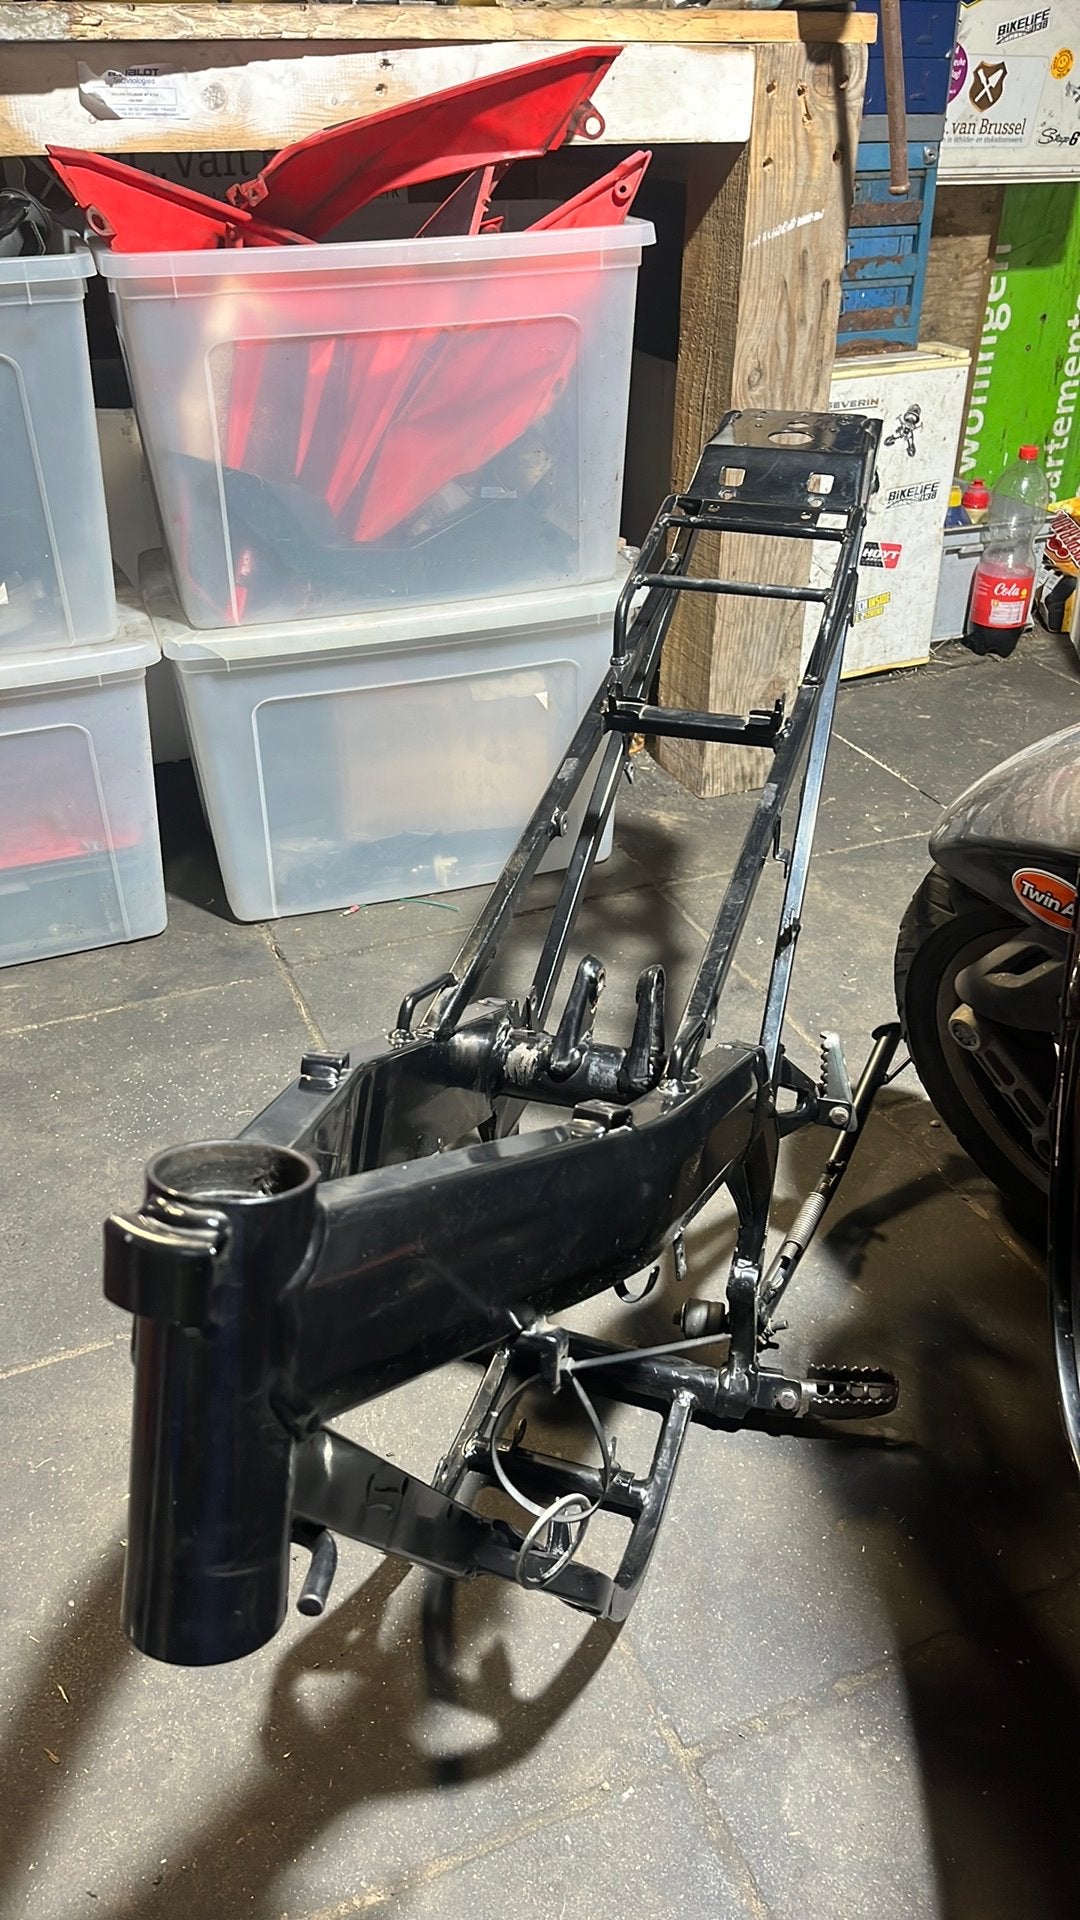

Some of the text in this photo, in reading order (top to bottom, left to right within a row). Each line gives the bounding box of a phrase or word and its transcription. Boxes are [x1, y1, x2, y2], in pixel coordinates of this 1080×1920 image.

[952, 118, 1026, 135] van Brussel
[862, 548, 900, 560] HOYT
[993, 582, 1020, 597] Cola
[1020, 880, 1061, 912] Twin
